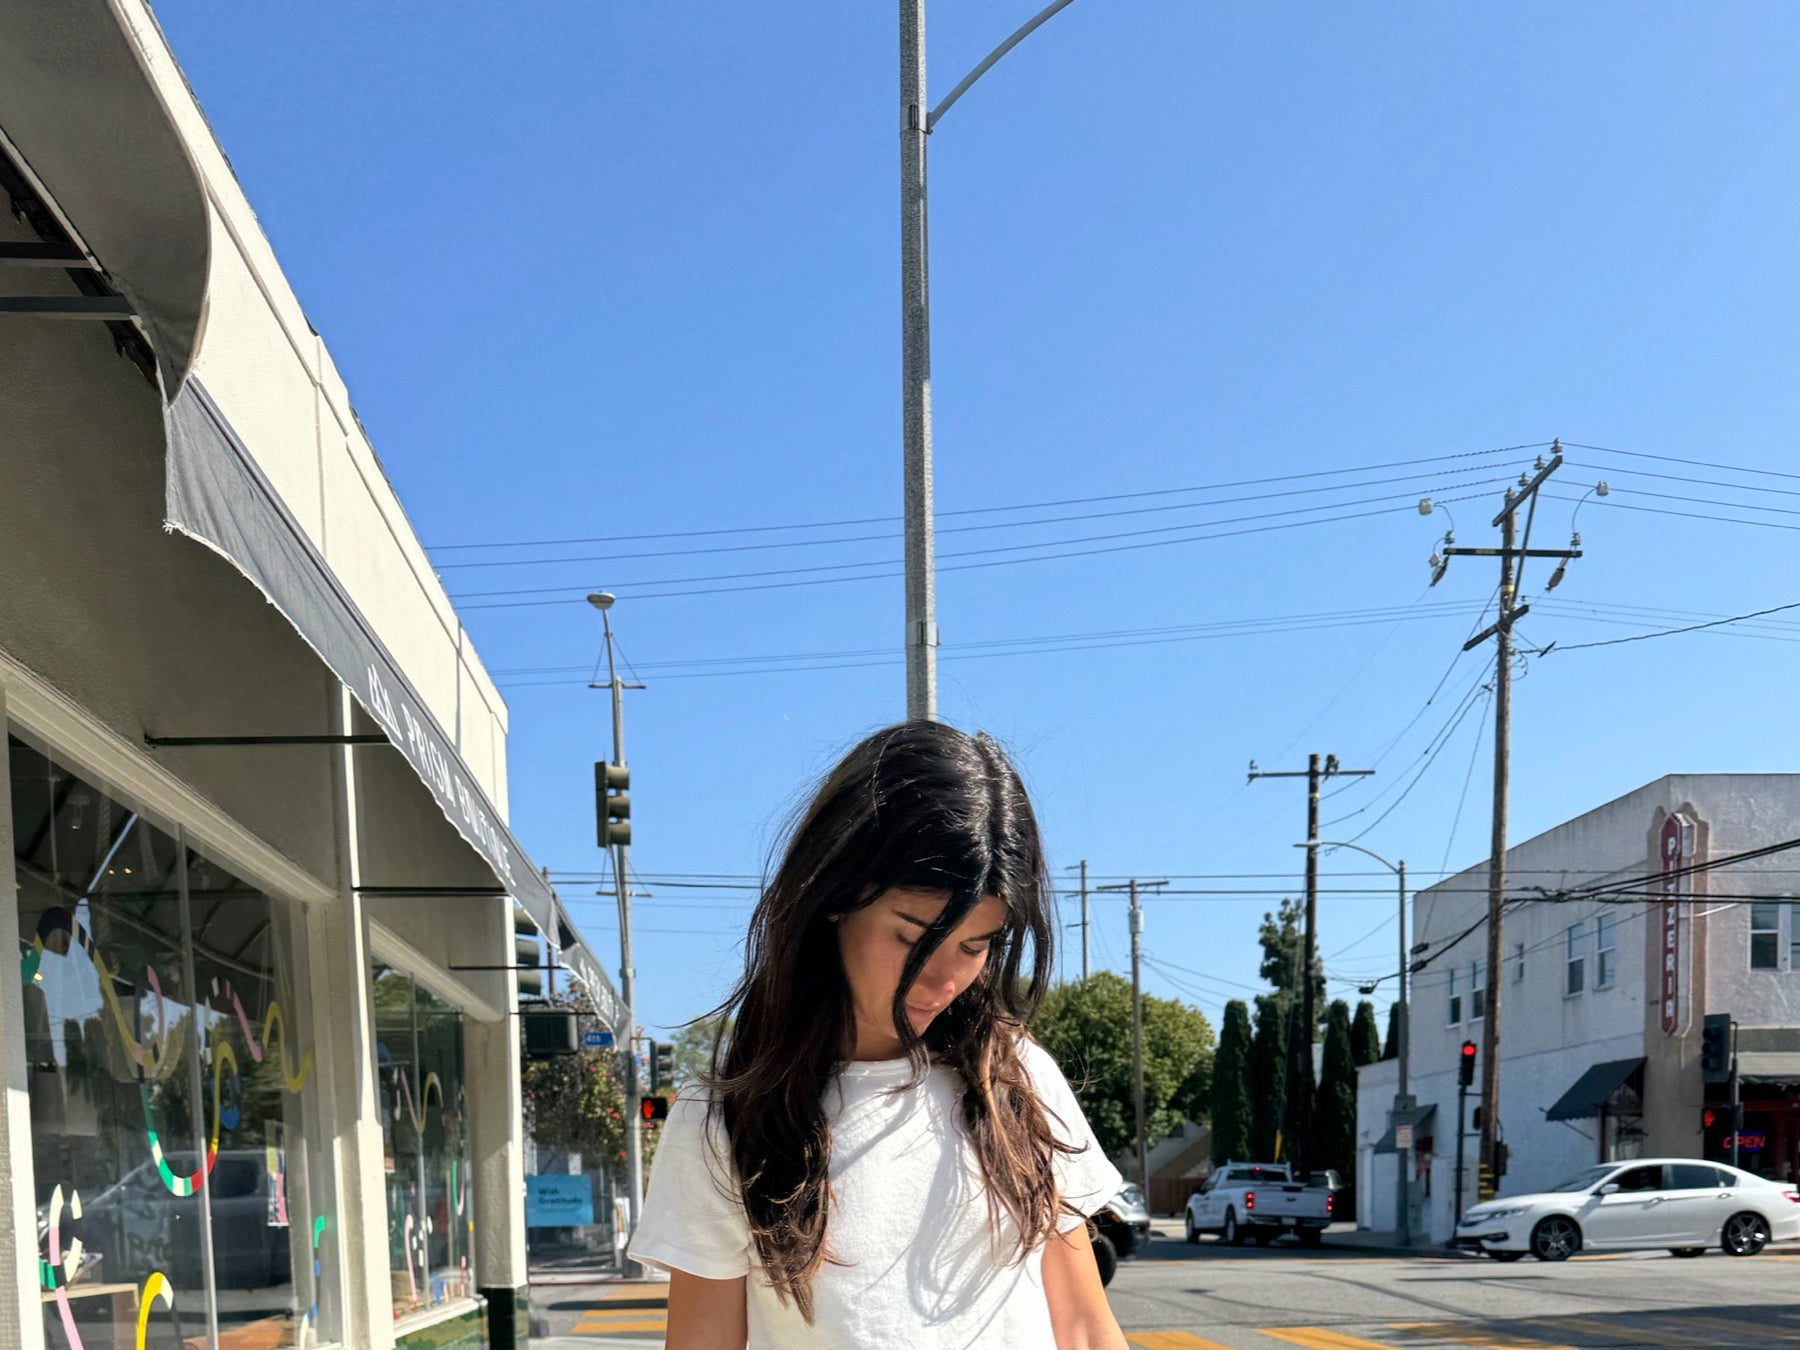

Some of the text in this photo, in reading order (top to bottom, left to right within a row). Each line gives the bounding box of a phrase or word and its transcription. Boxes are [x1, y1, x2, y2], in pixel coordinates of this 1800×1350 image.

[401, 702, 457, 808] PRISM
[1665, 836, 1677, 1019] PIZZERIA
[1722, 1135, 1766, 1150] OPEN
